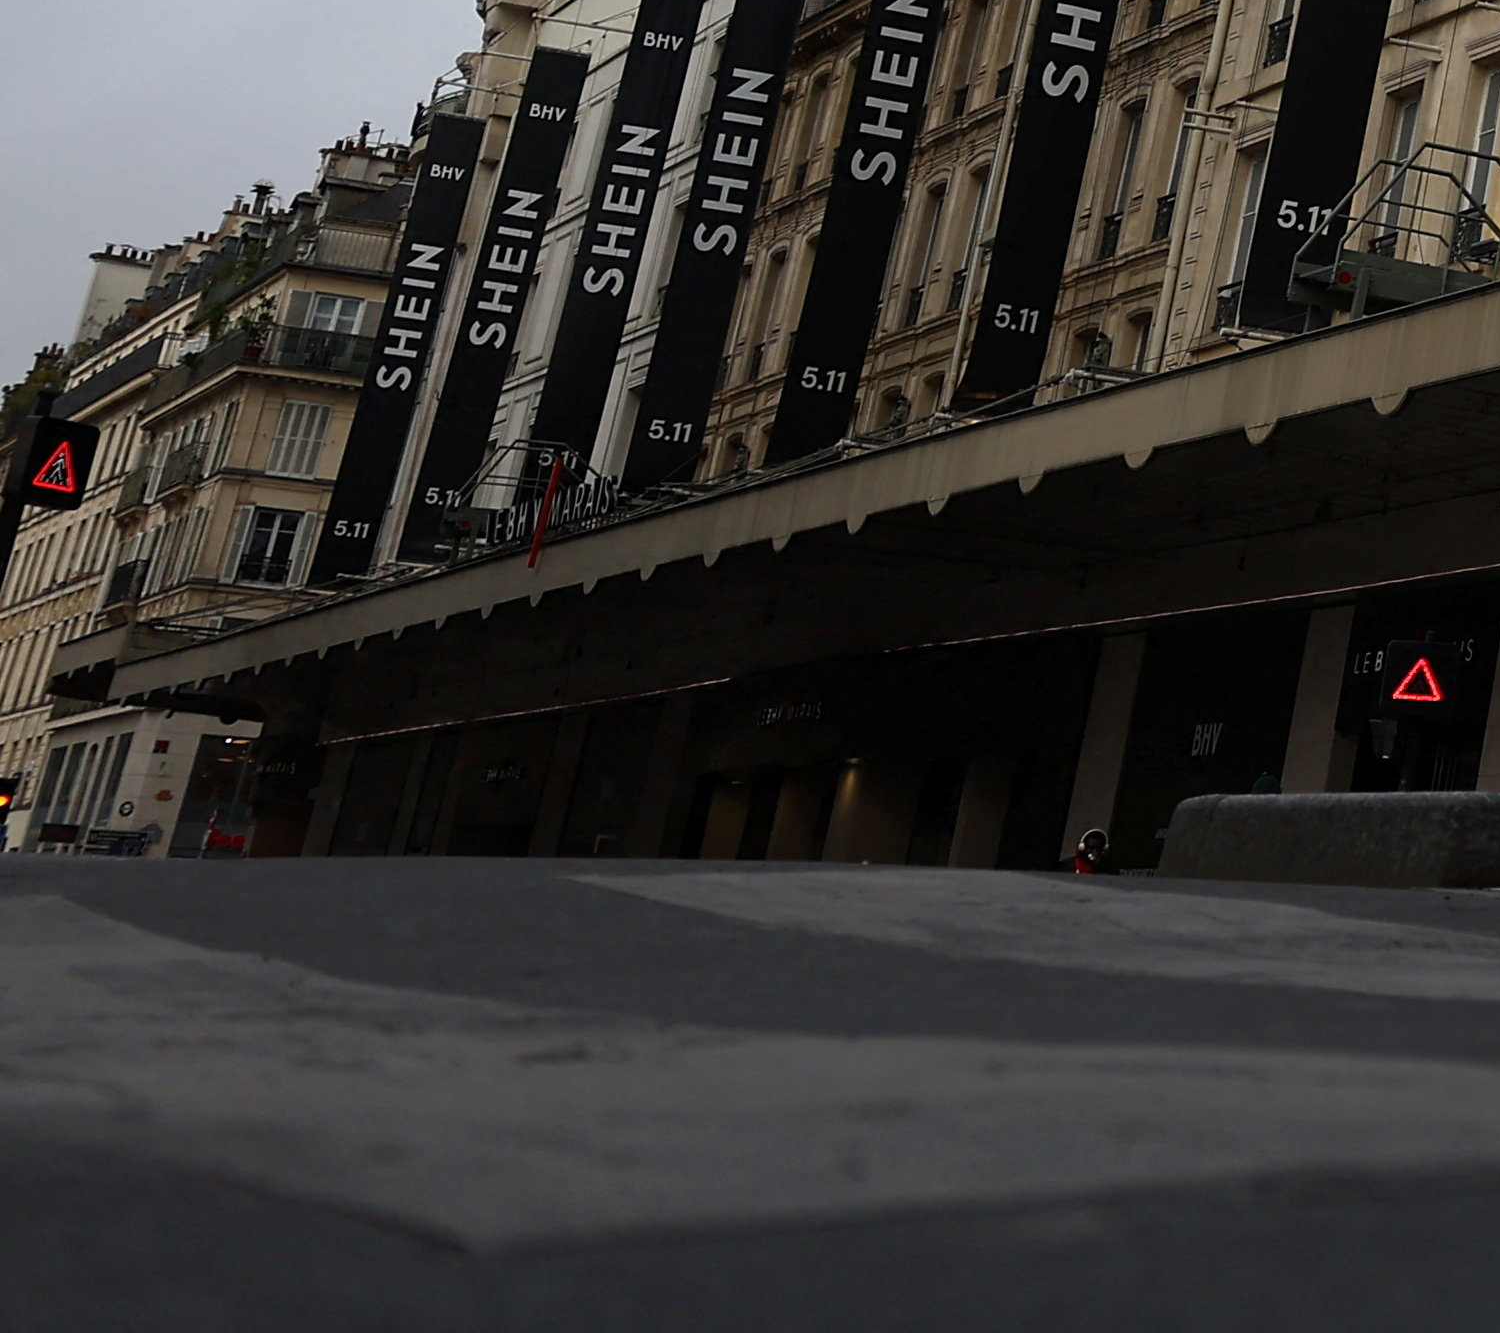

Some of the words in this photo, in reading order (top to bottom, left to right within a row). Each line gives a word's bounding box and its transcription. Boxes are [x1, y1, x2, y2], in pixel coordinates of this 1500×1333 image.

[643, 31, 684, 51] BHV
[529, 102, 567, 122] BHV
[429, 163, 465, 181] BHV
[693, 67, 775, 256] SHEIN
[582, 124, 661, 297] SHEIN
[1277, 199, 1333, 236] 5.11
[468, 189, 544, 349] SHEIN
[375, 242, 446, 391] SHEIN
[994, 303, 1039, 334] 5.11
[800, 366, 847, 393] 5.11
[648, 419, 693, 443] 5.11
[424, 486, 462, 508] 5.11
[333, 519, 370, 539] 5.11
[1191, 722, 1223, 757] BHV
